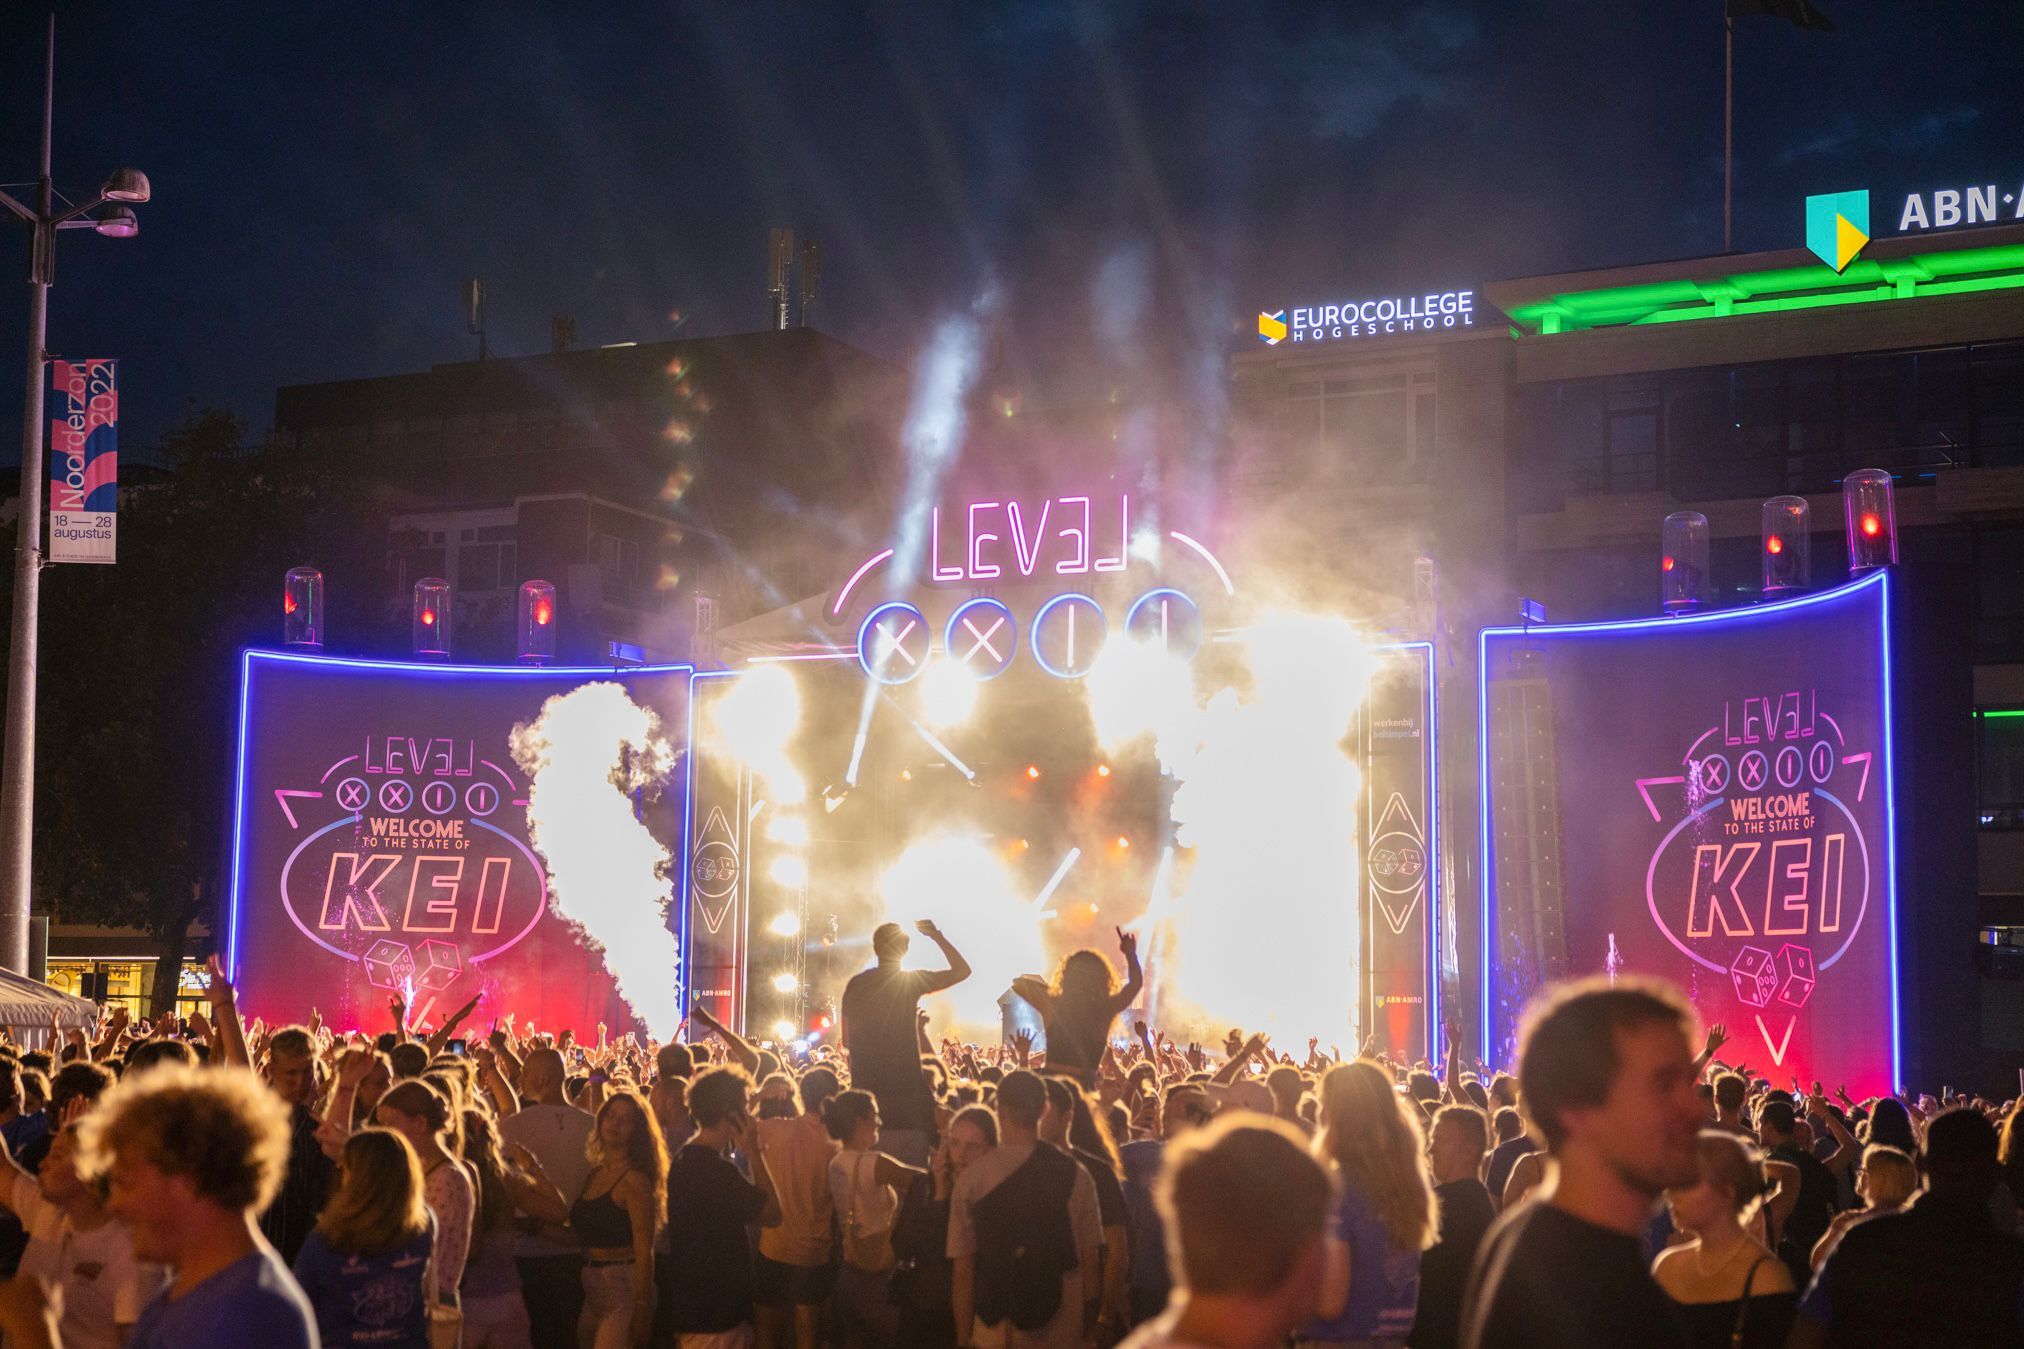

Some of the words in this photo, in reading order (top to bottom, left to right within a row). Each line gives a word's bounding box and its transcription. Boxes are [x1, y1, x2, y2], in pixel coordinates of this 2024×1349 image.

[1293, 291, 1473, 329] EUROCOLLEGE
[1293, 313, 1473, 342] HOGESCHOOL
[90, 363, 115, 428] 2022
[60, 363, 87, 508] Noorderzon
[54, 515, 68, 527] 18
[95, 516, 112, 528] 28
[54, 528, 112, 541] augustus
[932, 494, 1129, 581] LEVEL
[1725, 689, 1815, 745] LEVEL
[365, 736, 474, 776] LEVEL
[1724, 823, 1739, 835] TO
[1743, 822, 1764, 834] THE
[1768, 818, 1800, 832] STATE
[1803, 816, 1815, 829] OF
[1730, 792, 1810, 821] WELCOME
[362, 836, 378, 847] TO
[384, 837, 407, 849] THE
[412, 839, 449, 850] STATE
[455, 840, 471, 850] OF
[369, 817, 464, 839] WELCOME
[318, 852, 512, 934] KEI
[1686, 833, 1846, 937] KEI
